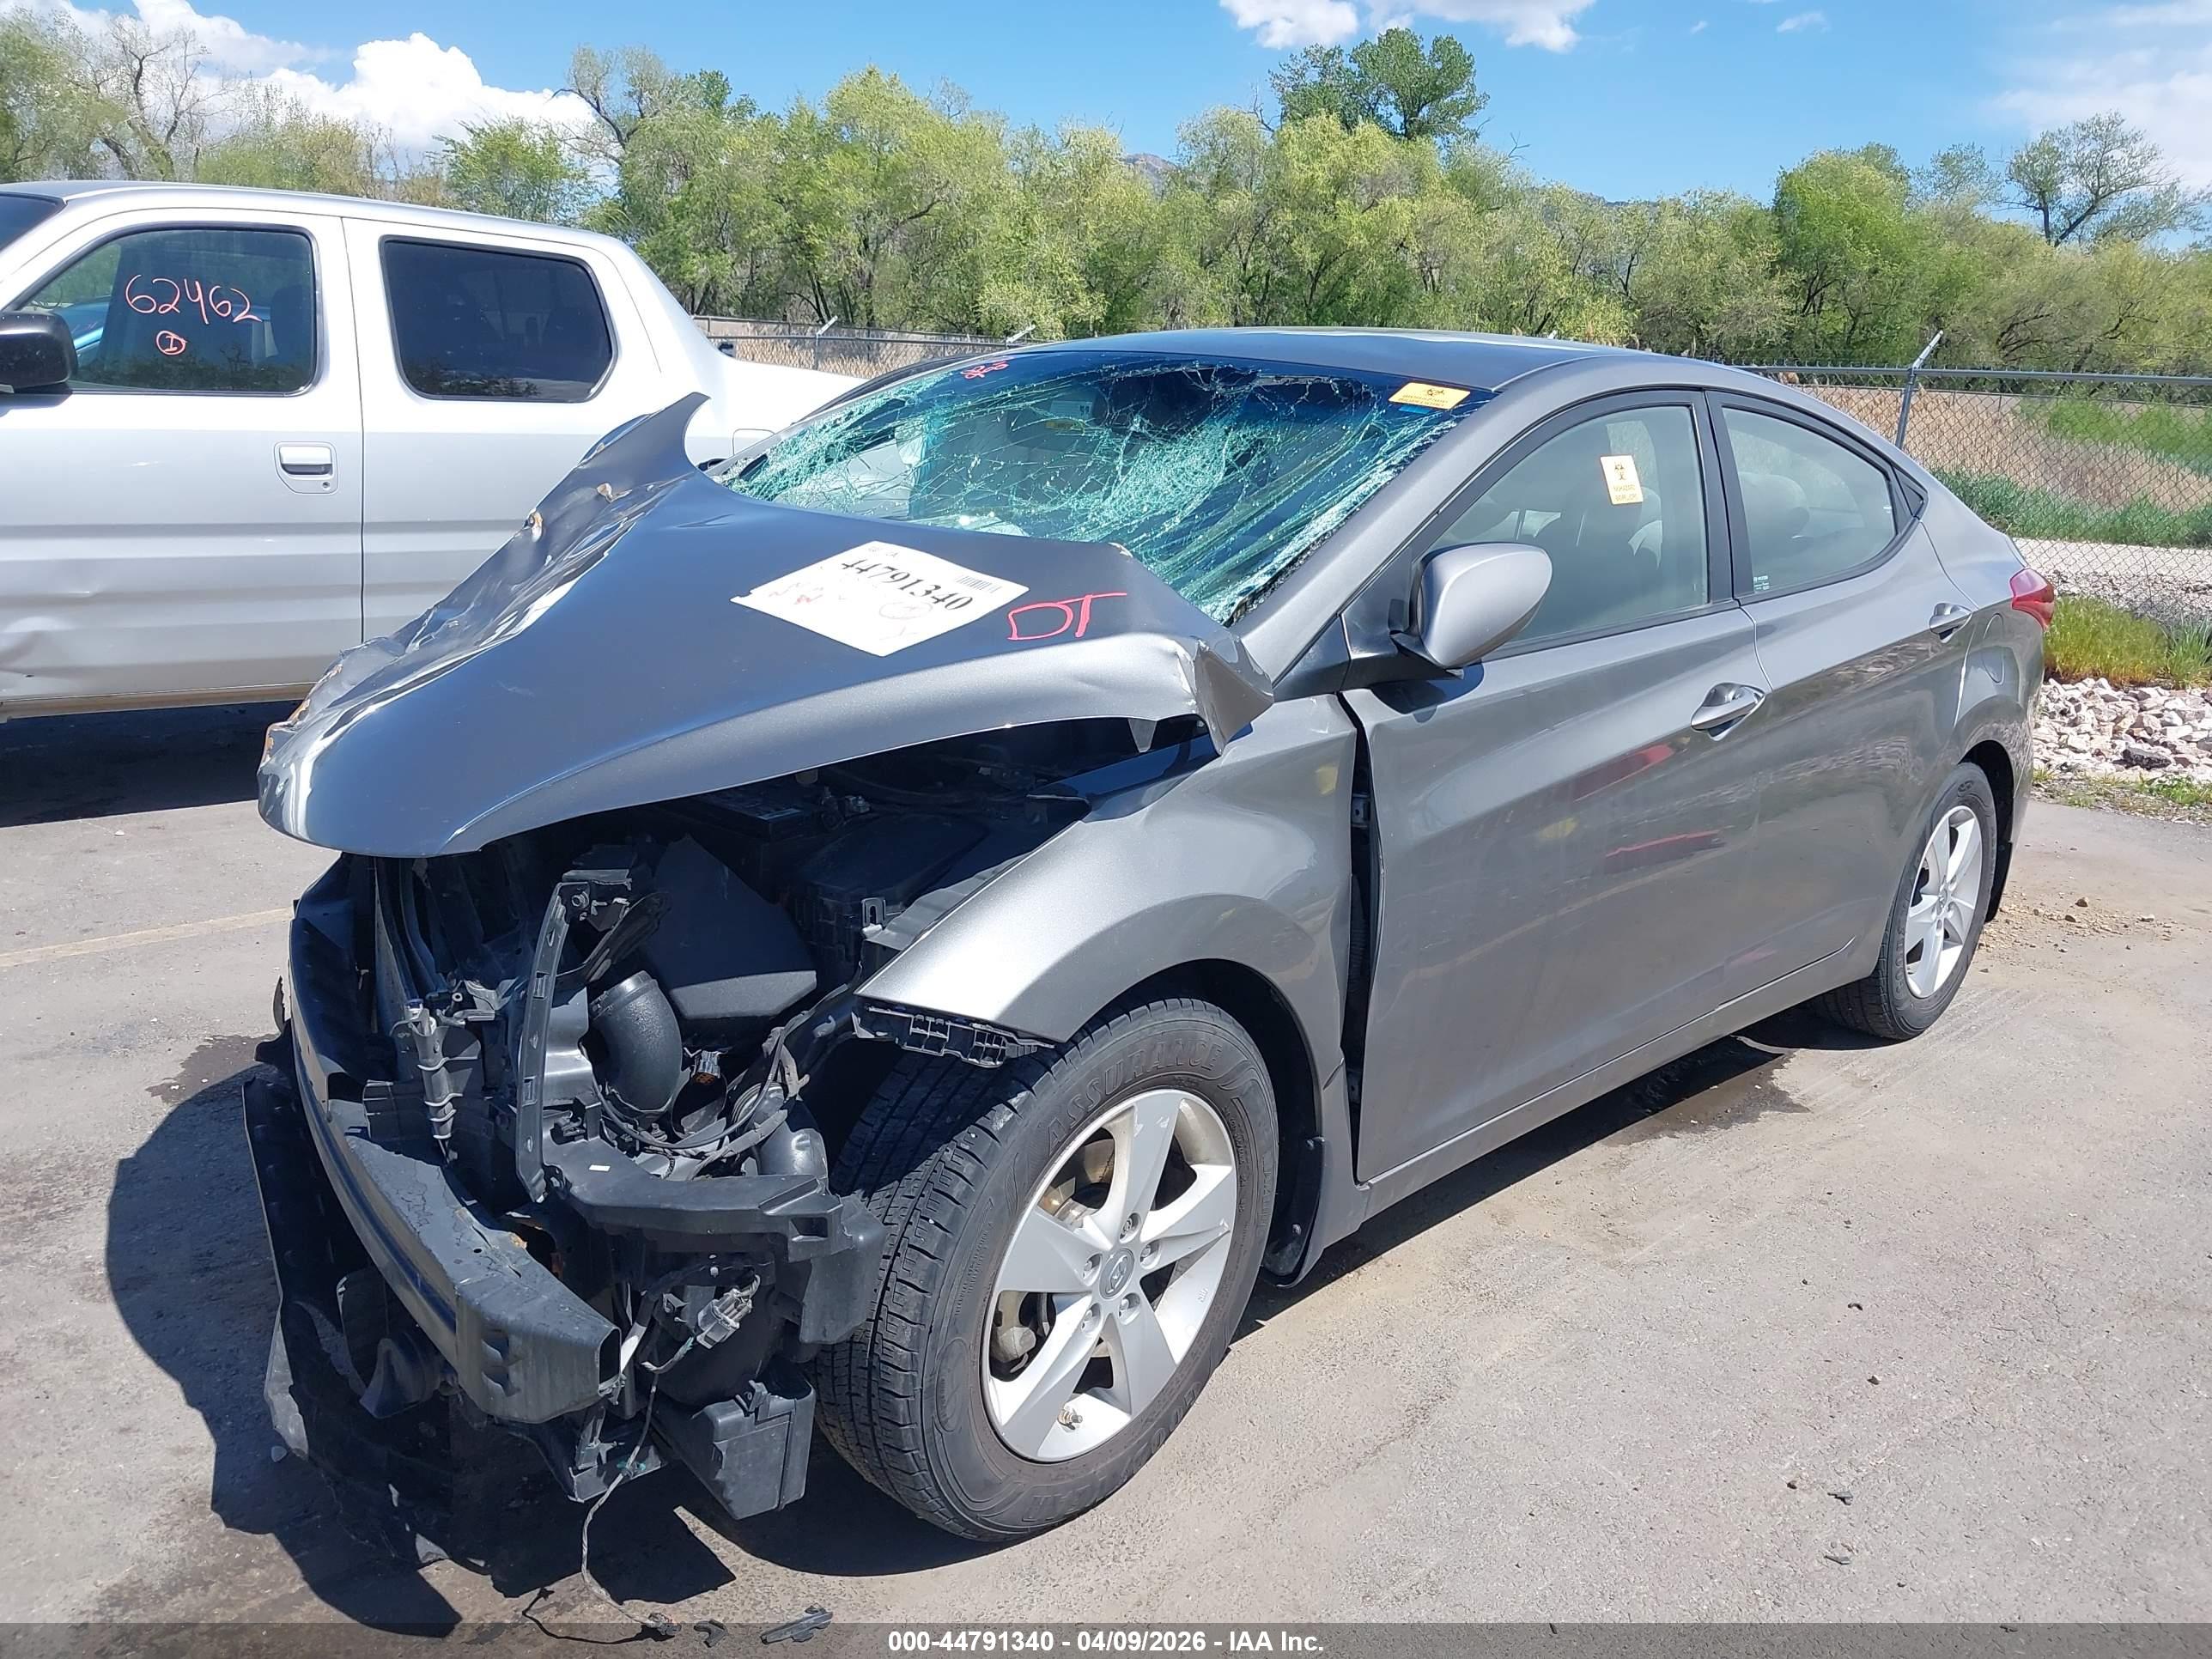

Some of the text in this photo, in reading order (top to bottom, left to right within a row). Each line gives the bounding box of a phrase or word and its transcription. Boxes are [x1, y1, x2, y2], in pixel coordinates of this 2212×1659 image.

[125, 274, 263, 325] 62462
[842, 558, 974, 611] 44791340
[1048, 1039, 1223, 1153] ASSURANCE
